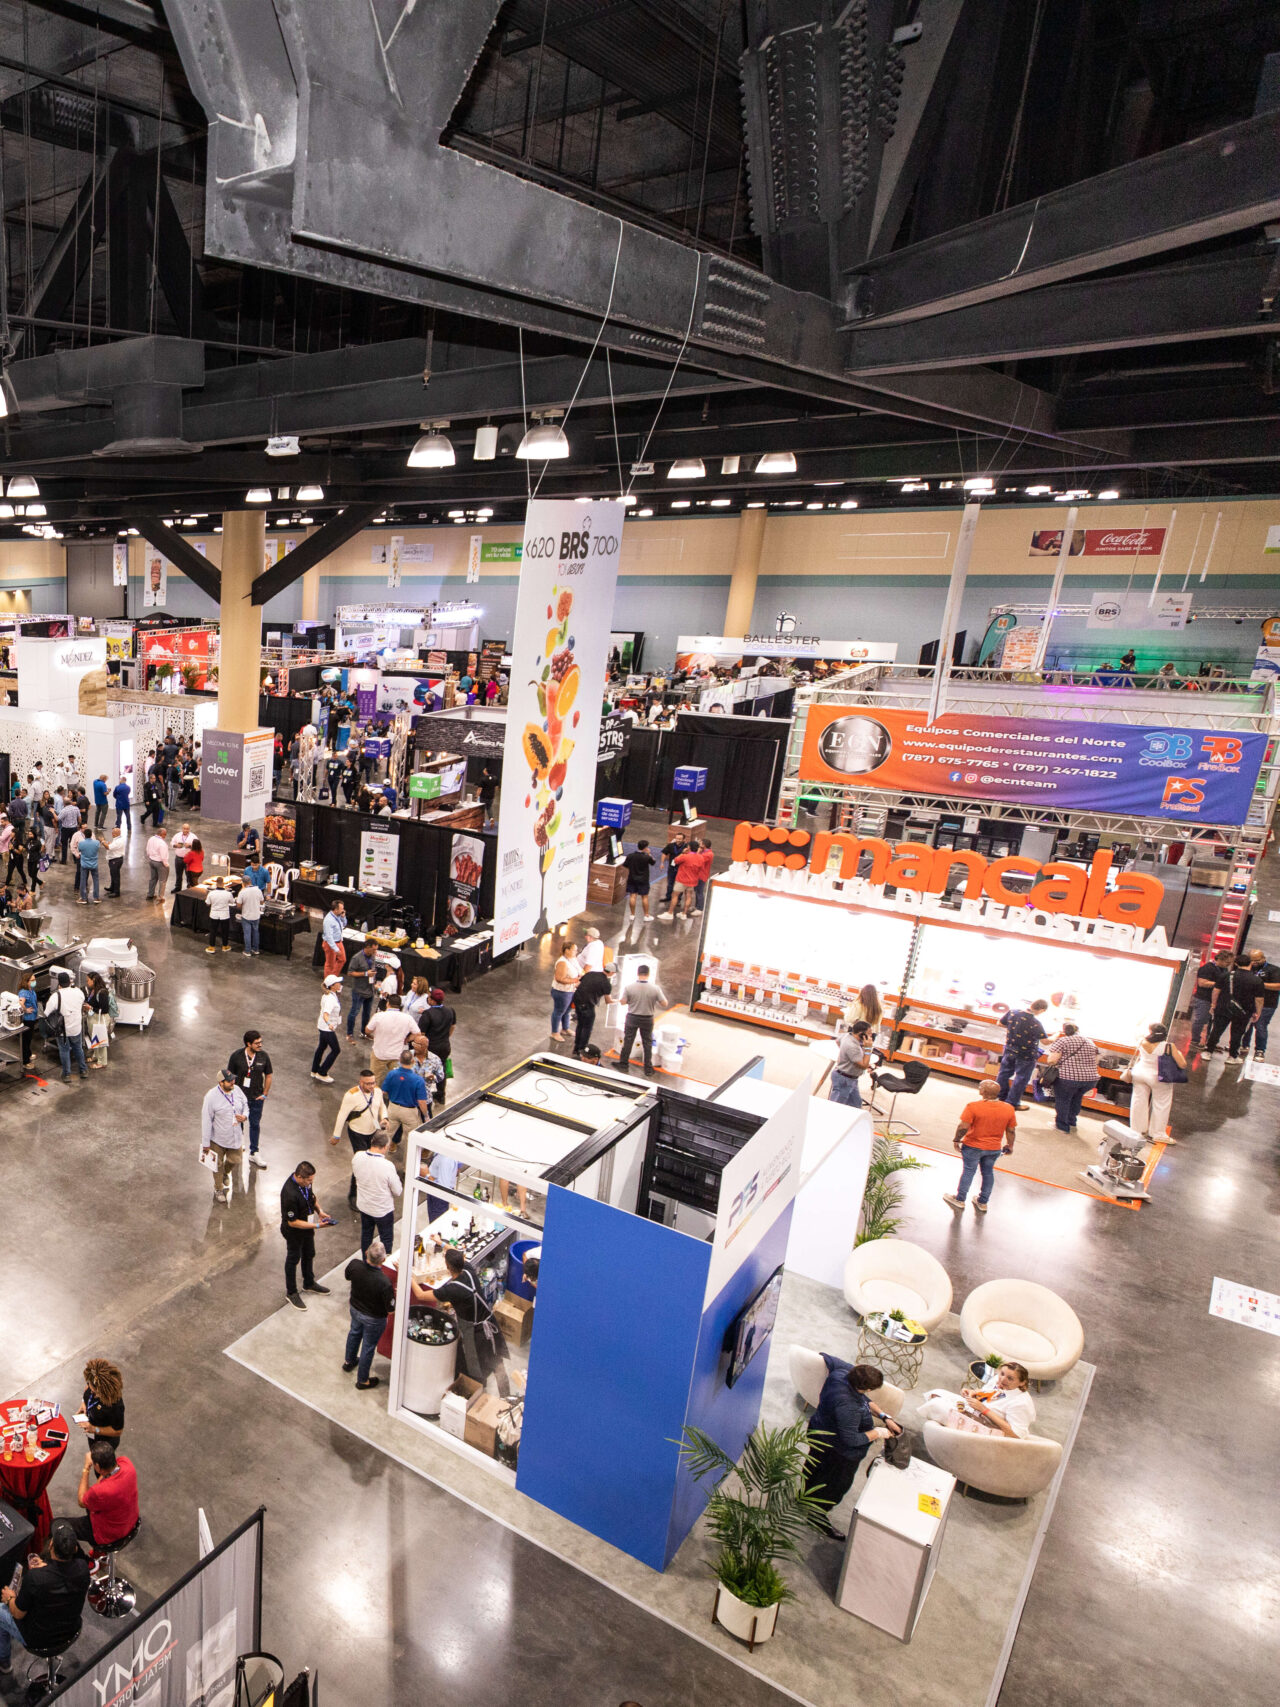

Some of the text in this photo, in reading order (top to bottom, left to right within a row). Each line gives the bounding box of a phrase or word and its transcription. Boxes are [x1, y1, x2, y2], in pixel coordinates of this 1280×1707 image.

[559, 531, 590, 560] BRS
[1098, 608, 1117, 616] BRS
[743, 634, 820, 646] BALLESTER
[906, 724, 1127, 748] Equipos Comerciales del Norte
[903, 739, 1123, 764] www.equipoderestaurantes.com
[207, 763, 239, 777] clover
[902, 753, 1118, 779] (787) 675-7765 (787) 247-1822
[1138, 757, 1187, 769] CoolBox
[980, 775, 1058, 789] @ecnteam
[810, 831, 1165, 930] mancala
